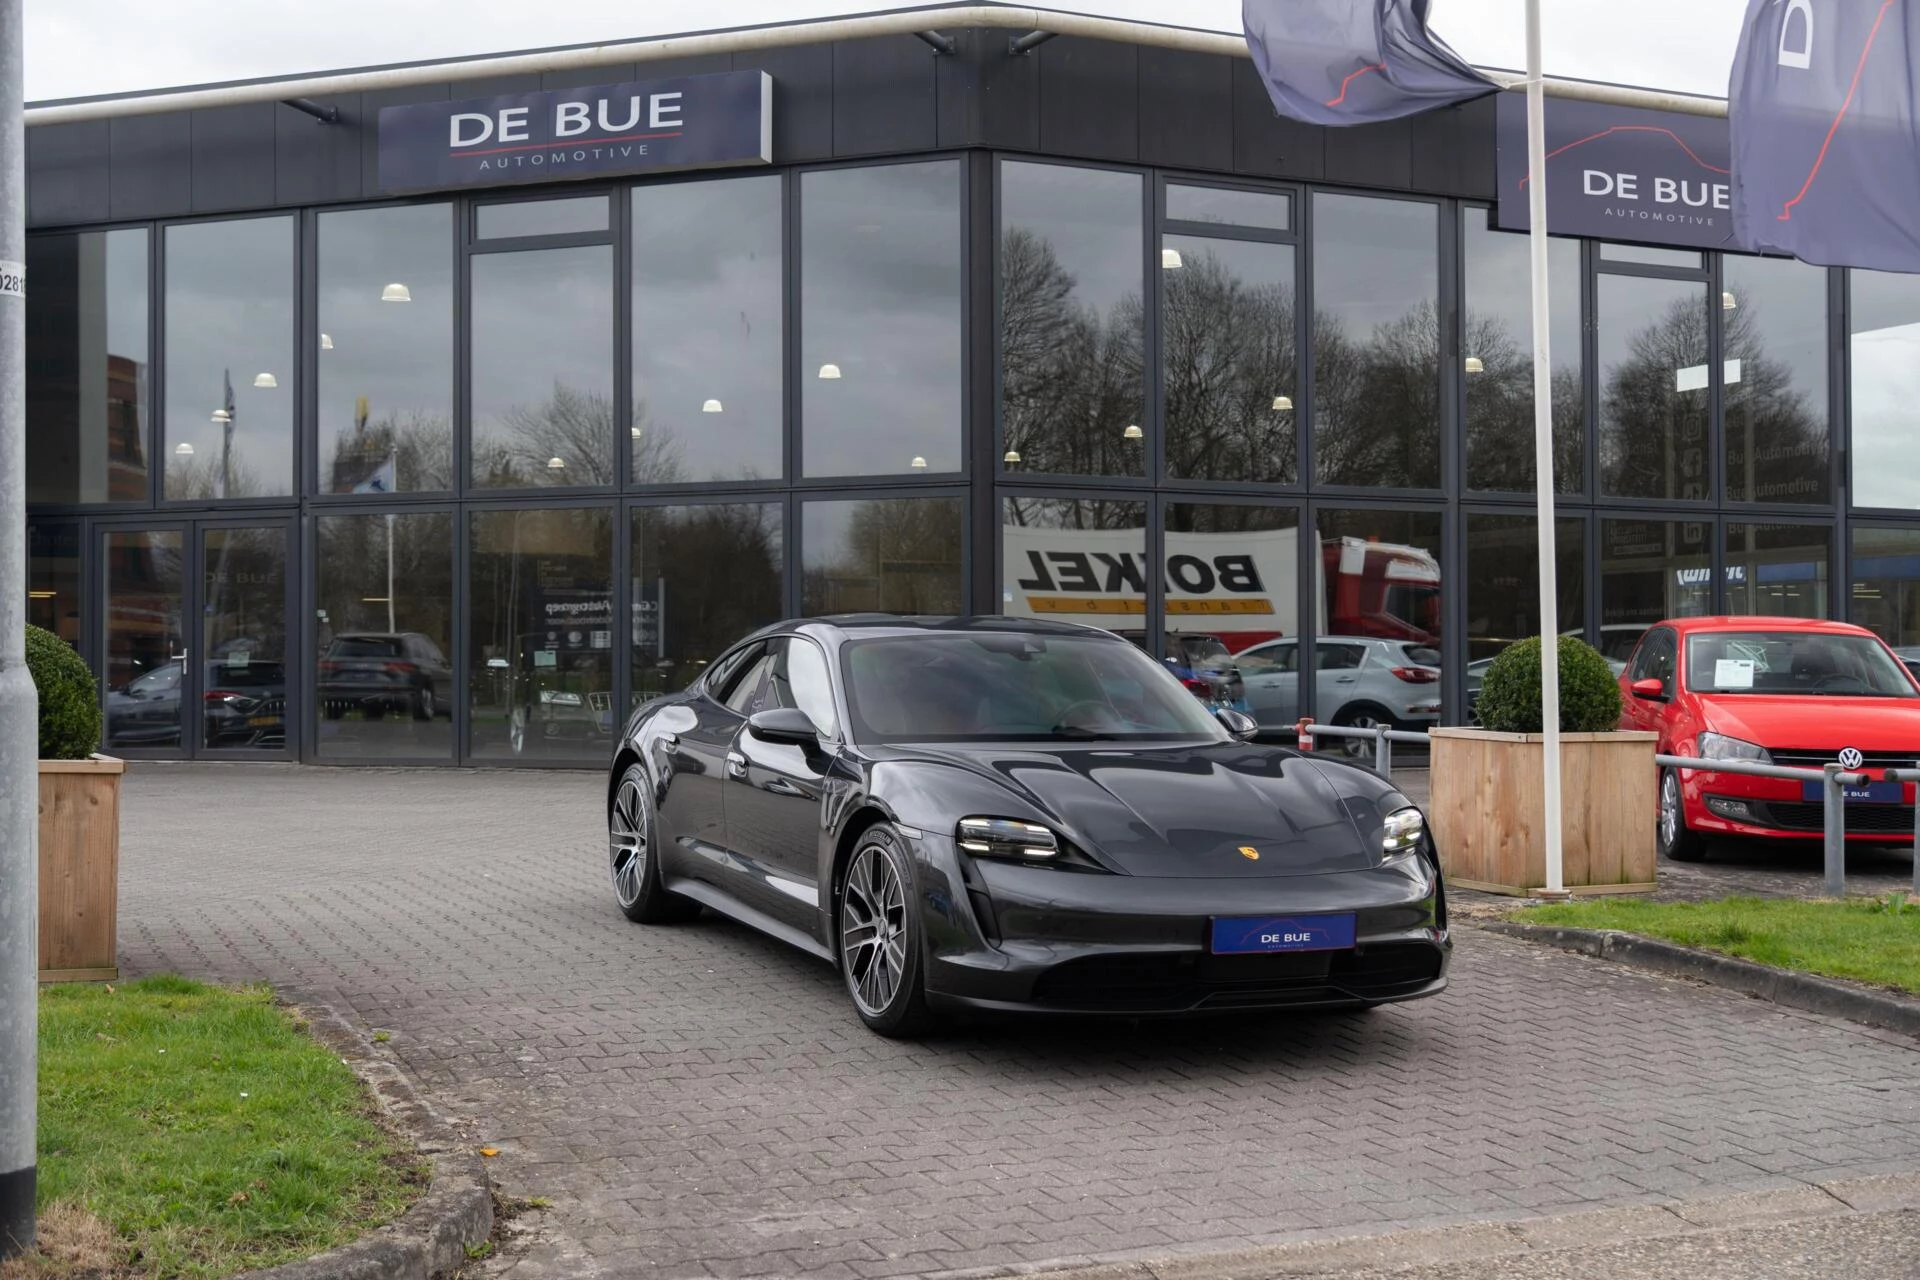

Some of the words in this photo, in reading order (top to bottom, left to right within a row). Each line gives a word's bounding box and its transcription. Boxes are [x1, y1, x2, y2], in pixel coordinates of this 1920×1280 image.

[450, 107, 529, 147] DE
[555, 92, 683, 137] BUE
[479, 145, 648, 170] AUTOMOTIVE
[1583, 169, 1638, 200] DE
[1654, 177, 1730, 210] BUE
[1605, 207, 1714, 227] AUTOMOTIVE
[1261, 934, 1280, 943] DE
[1284, 932, 1311, 942] BUE
